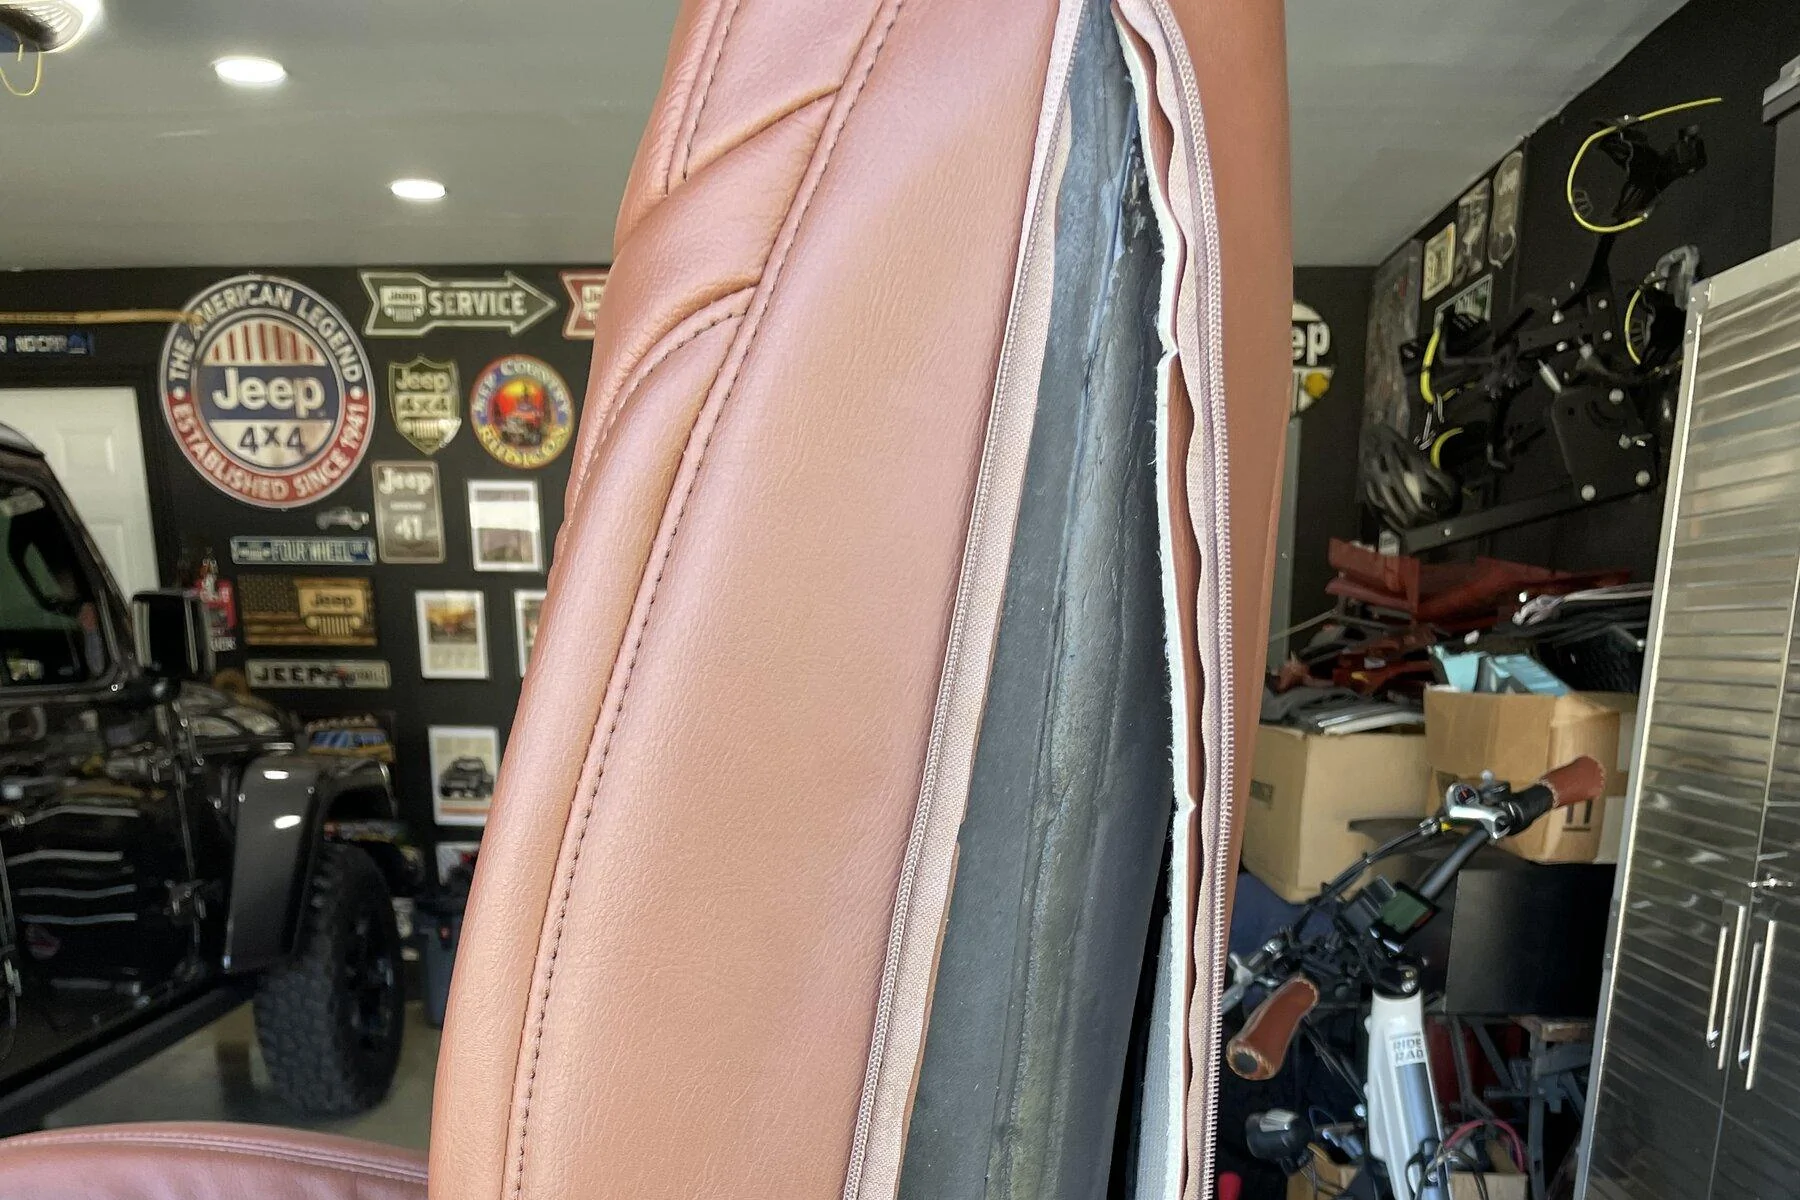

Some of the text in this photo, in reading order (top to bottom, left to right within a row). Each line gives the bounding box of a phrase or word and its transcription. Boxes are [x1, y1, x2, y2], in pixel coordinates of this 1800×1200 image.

[428, 290, 528, 316] SERVICE
[168, 282, 364, 383] THE AMERICAN LEGEND
[212, 367, 326, 419] Jeep
[394, 367, 453, 393] Jeep
[171, 403, 369, 501] ESTABLISHED SINCE 1941
[378, 467, 432, 495] Jeep
